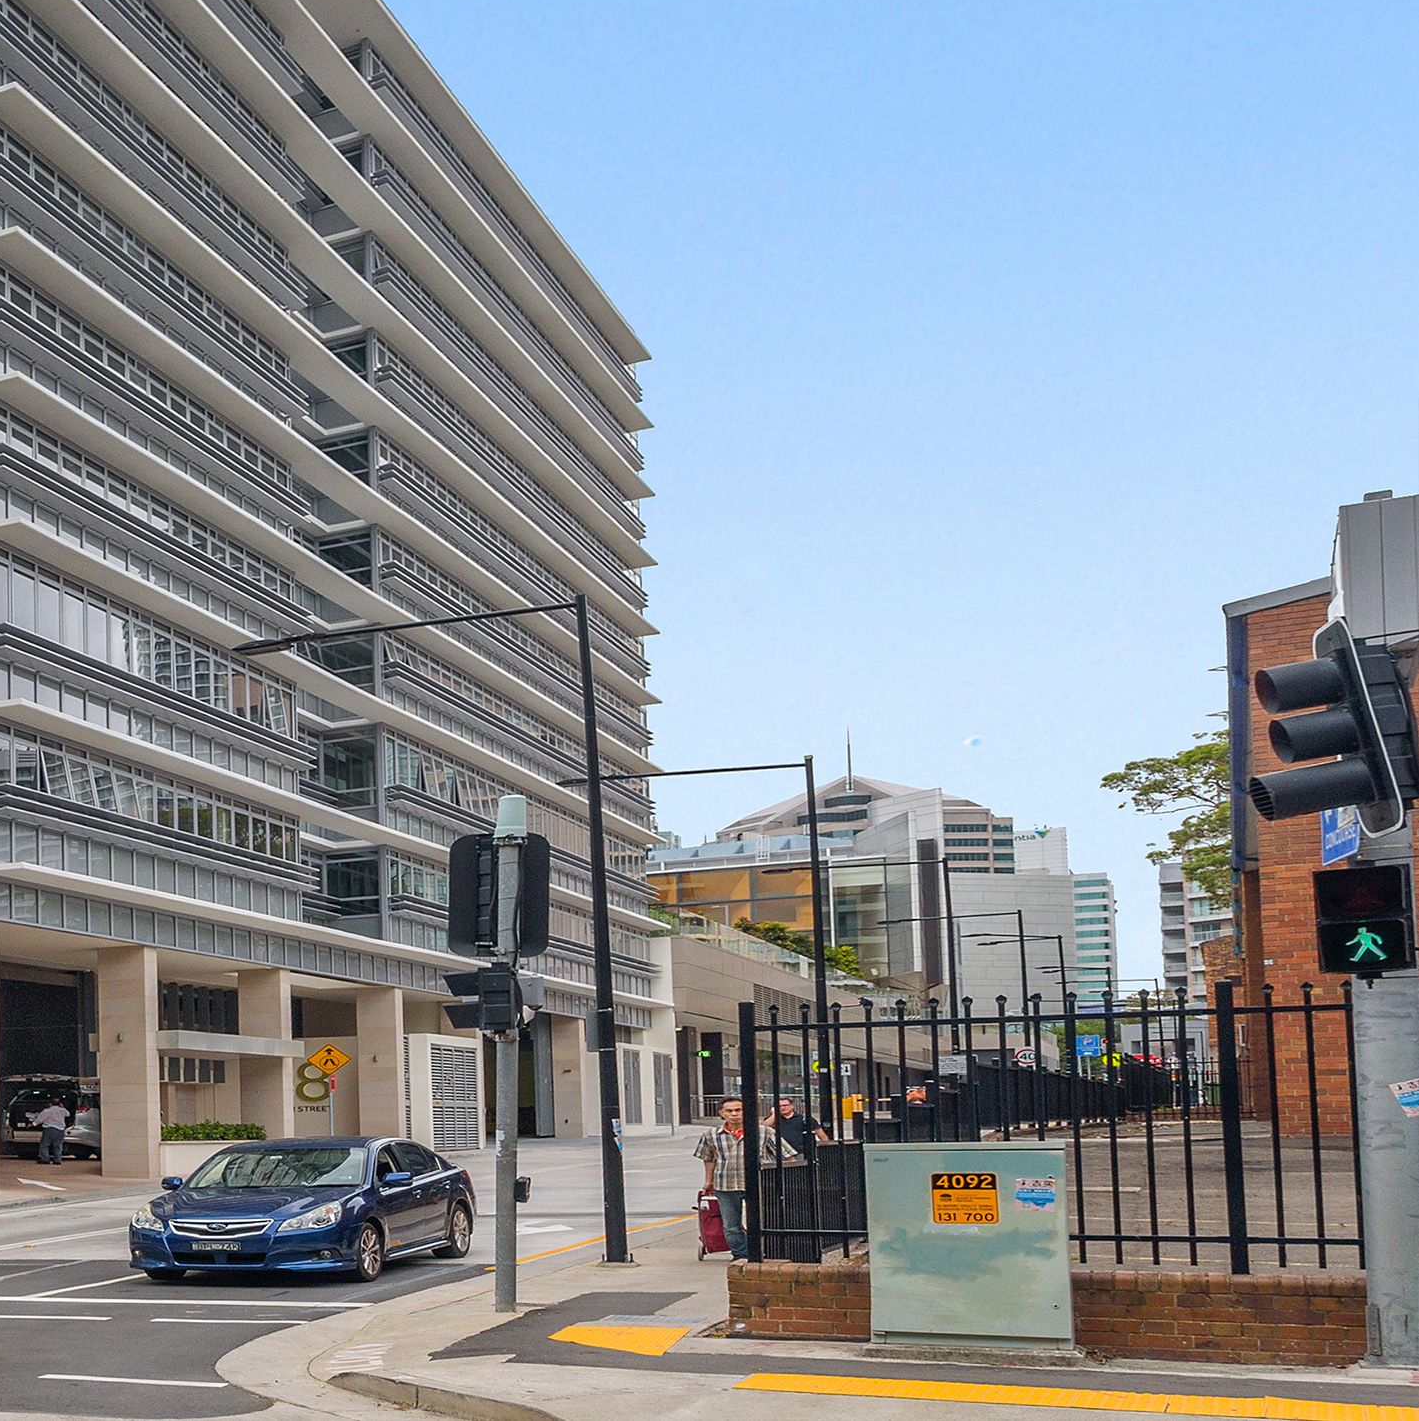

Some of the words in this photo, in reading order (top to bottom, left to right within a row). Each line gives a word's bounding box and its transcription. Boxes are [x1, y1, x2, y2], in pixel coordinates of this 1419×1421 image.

[1019, 1052, 1035, 1061] 40
[936, 1175, 993, 1188] 4092
[937, 1212, 957, 1222] 131
[963, 1212, 995, 1222] 700
